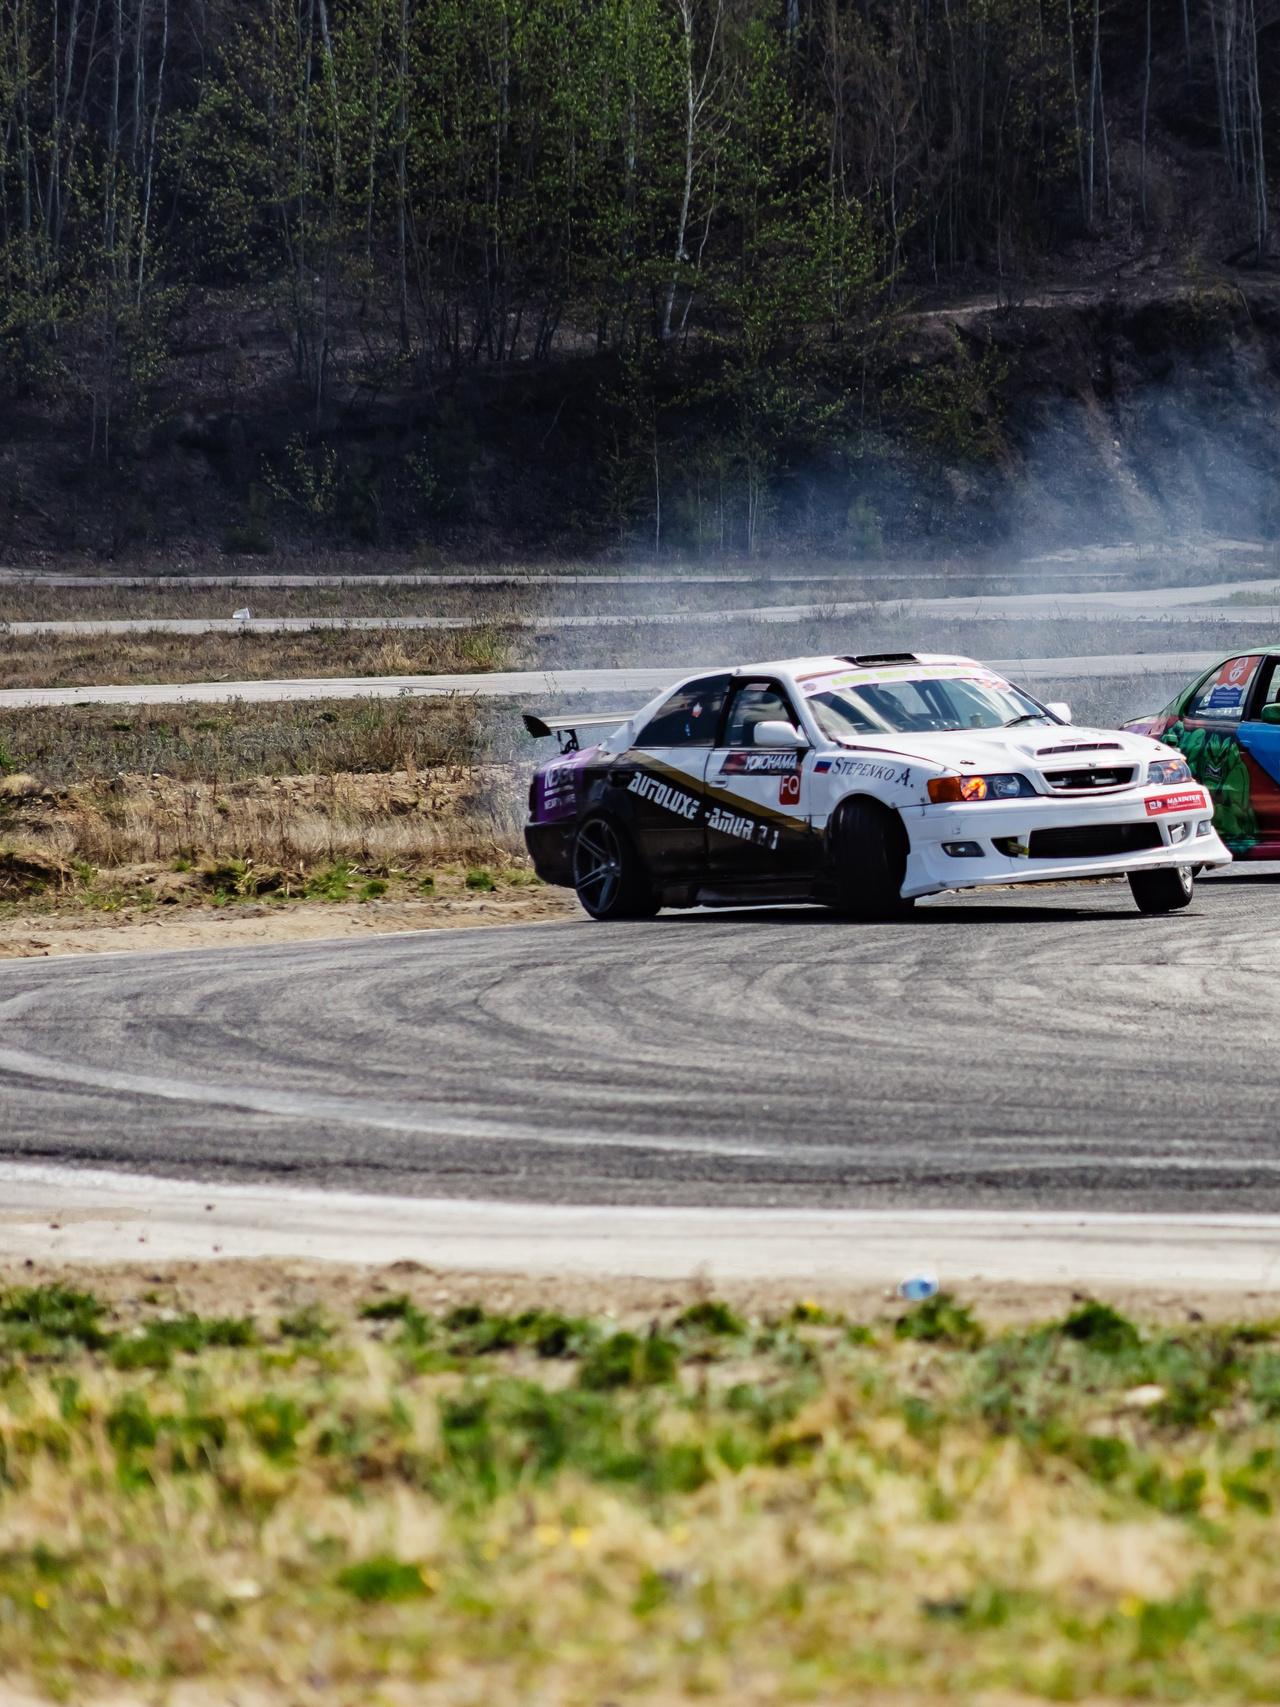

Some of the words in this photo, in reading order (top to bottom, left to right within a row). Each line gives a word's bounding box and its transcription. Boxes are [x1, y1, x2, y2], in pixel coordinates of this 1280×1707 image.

[744, 754, 798, 770] YOKOHAMA
[831, 757, 895, 781] STEPENKO
[895, 767, 914, 788] A.
[780, 775, 799, 795] FQ
